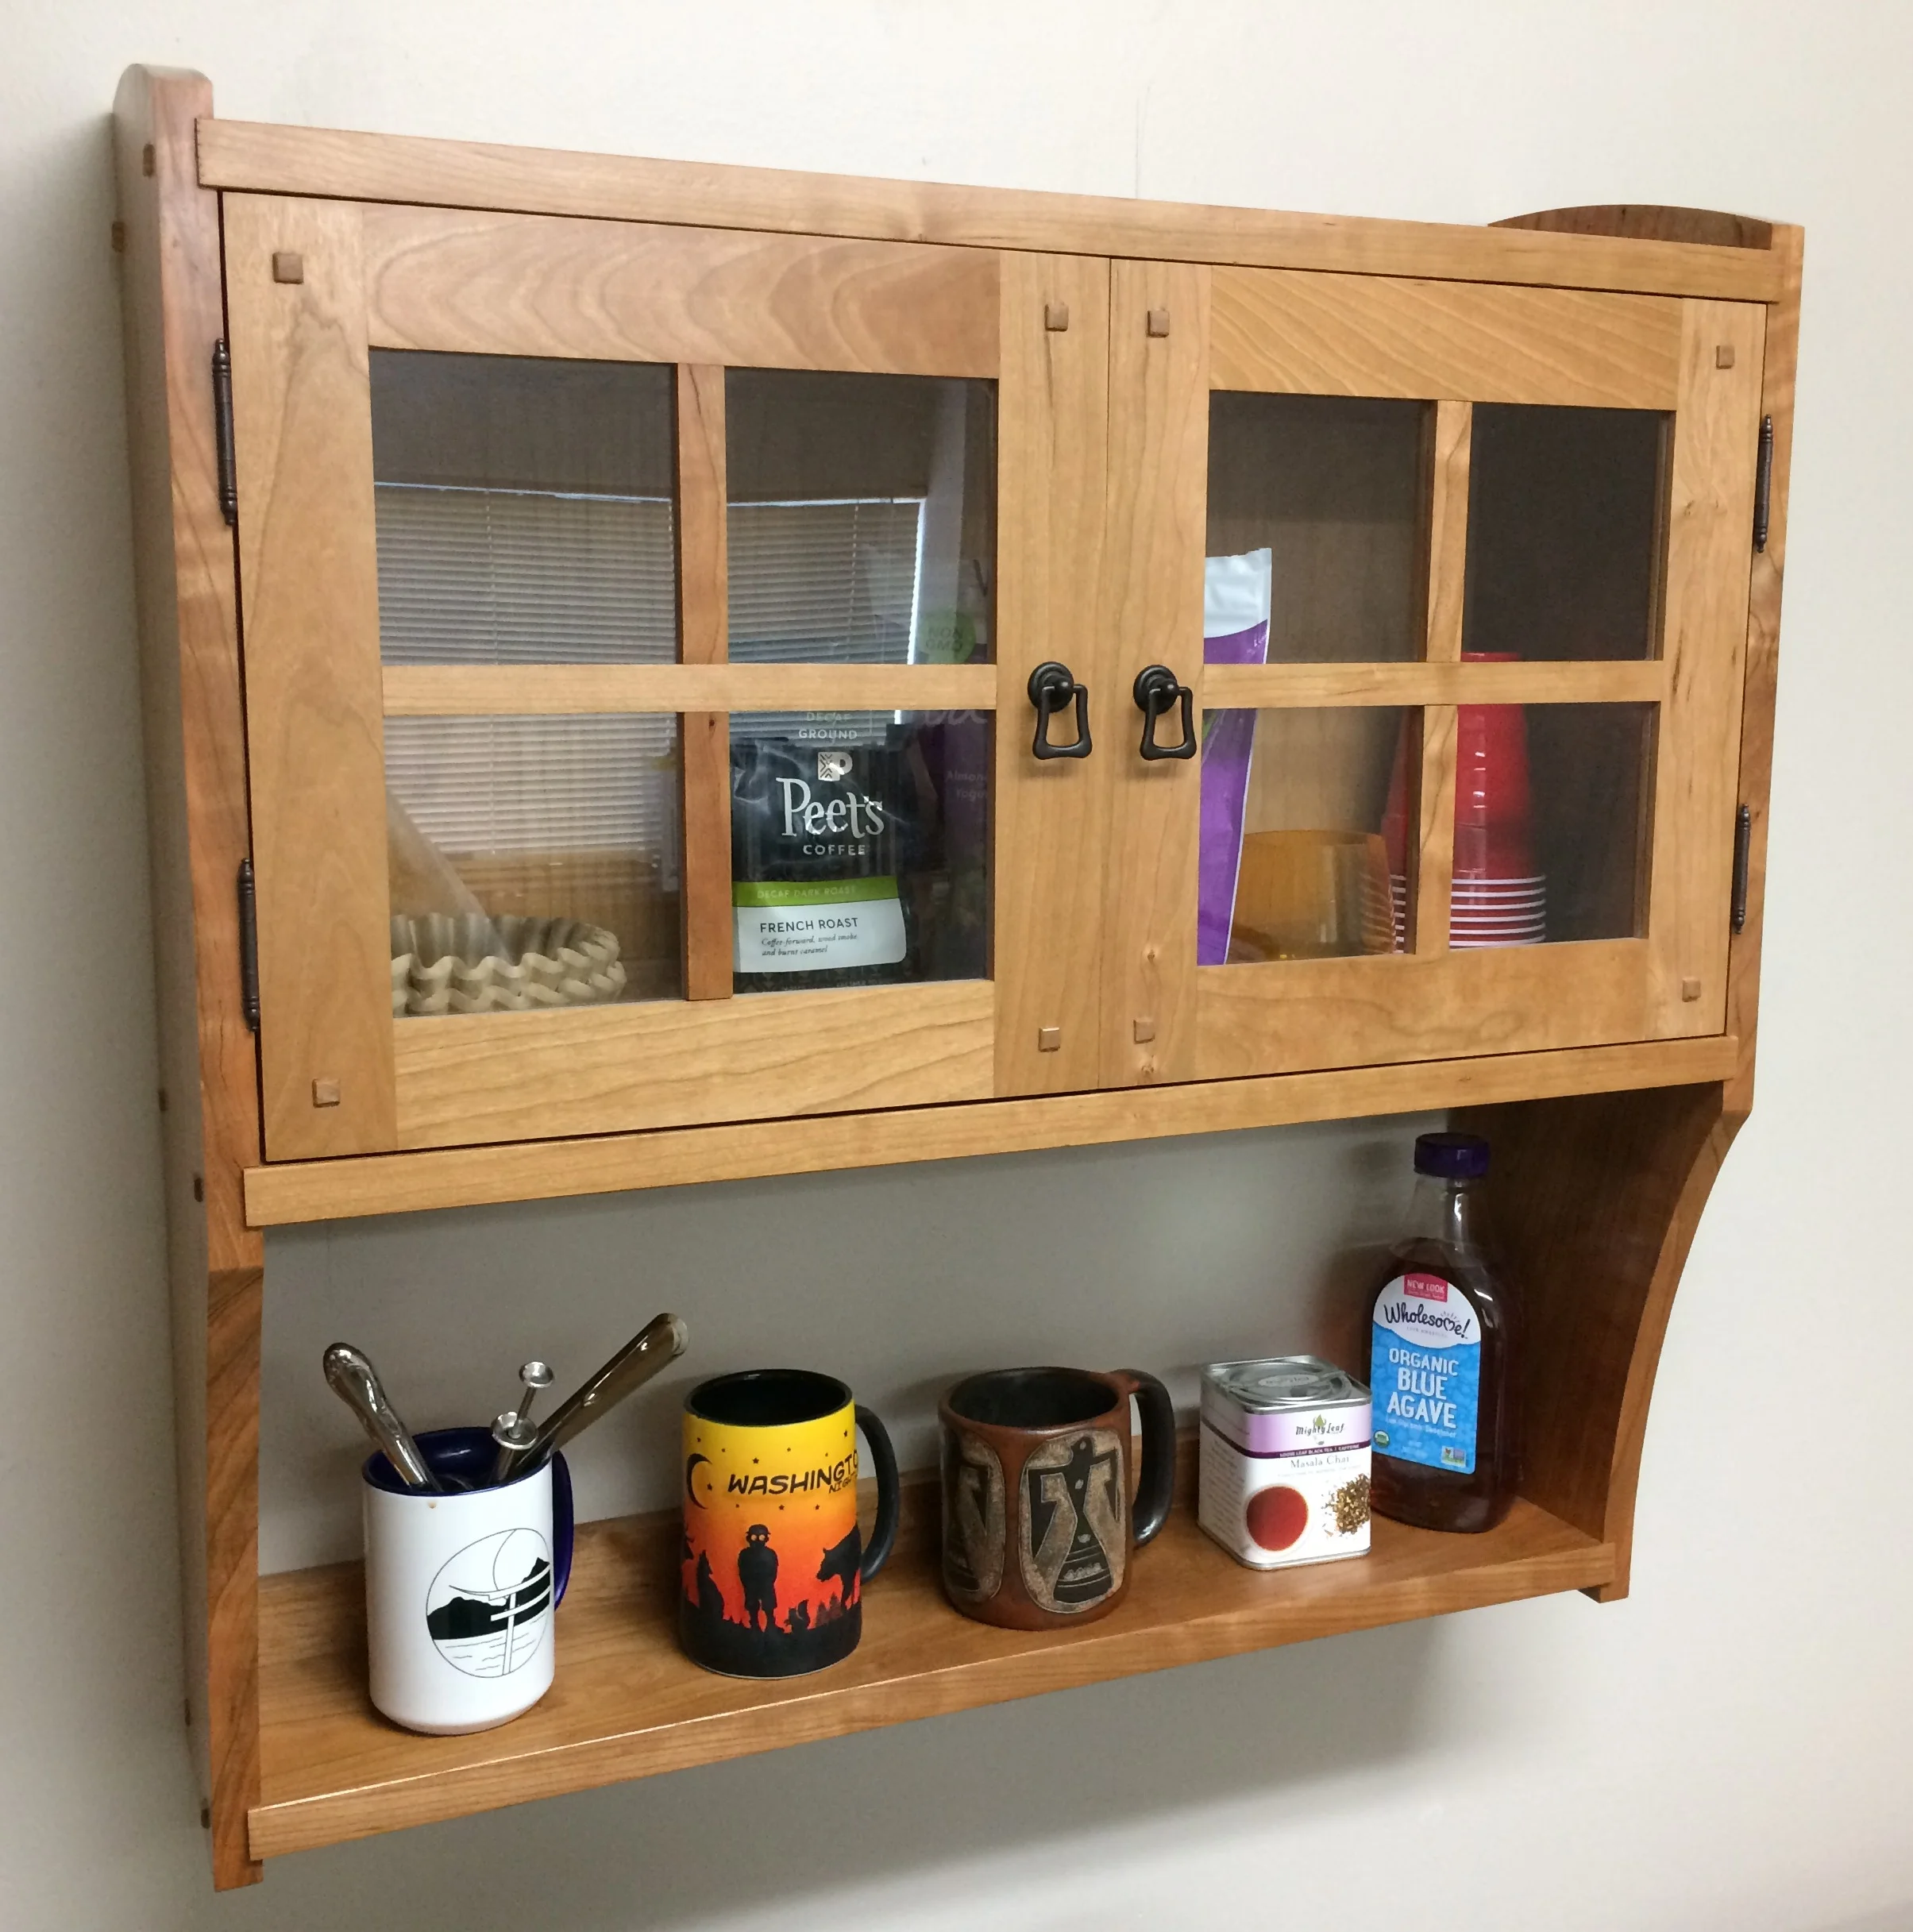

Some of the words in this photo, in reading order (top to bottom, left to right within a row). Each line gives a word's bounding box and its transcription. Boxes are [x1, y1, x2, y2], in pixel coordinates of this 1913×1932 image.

[798, 729, 858, 739] GROUND
[775, 777, 885, 839] Peet's
[803, 844, 866, 856] COFFEE
[757, 889, 790, 899] DECAF
[793, 889, 820, 897] DARK
[823, 885, 857, 895] ROAST
[760, 920, 814, 933] FRENCH
[818, 917, 858, 929] ROAST
[1406, 1279, 1425, 1290] NEW
[1426, 1283, 1445, 1294] LOOK
[1389, 1348, 1460, 1376] ORGANIC
[1398, 1367, 1448, 1401] BLUE
[1387, 1391, 1457, 1429] AGAVE
[1290, 1459, 1323, 1468] Masala
[1326, 1455, 1349, 1465] Chai
[727, 1448, 858, 1494] WASHINGTO
